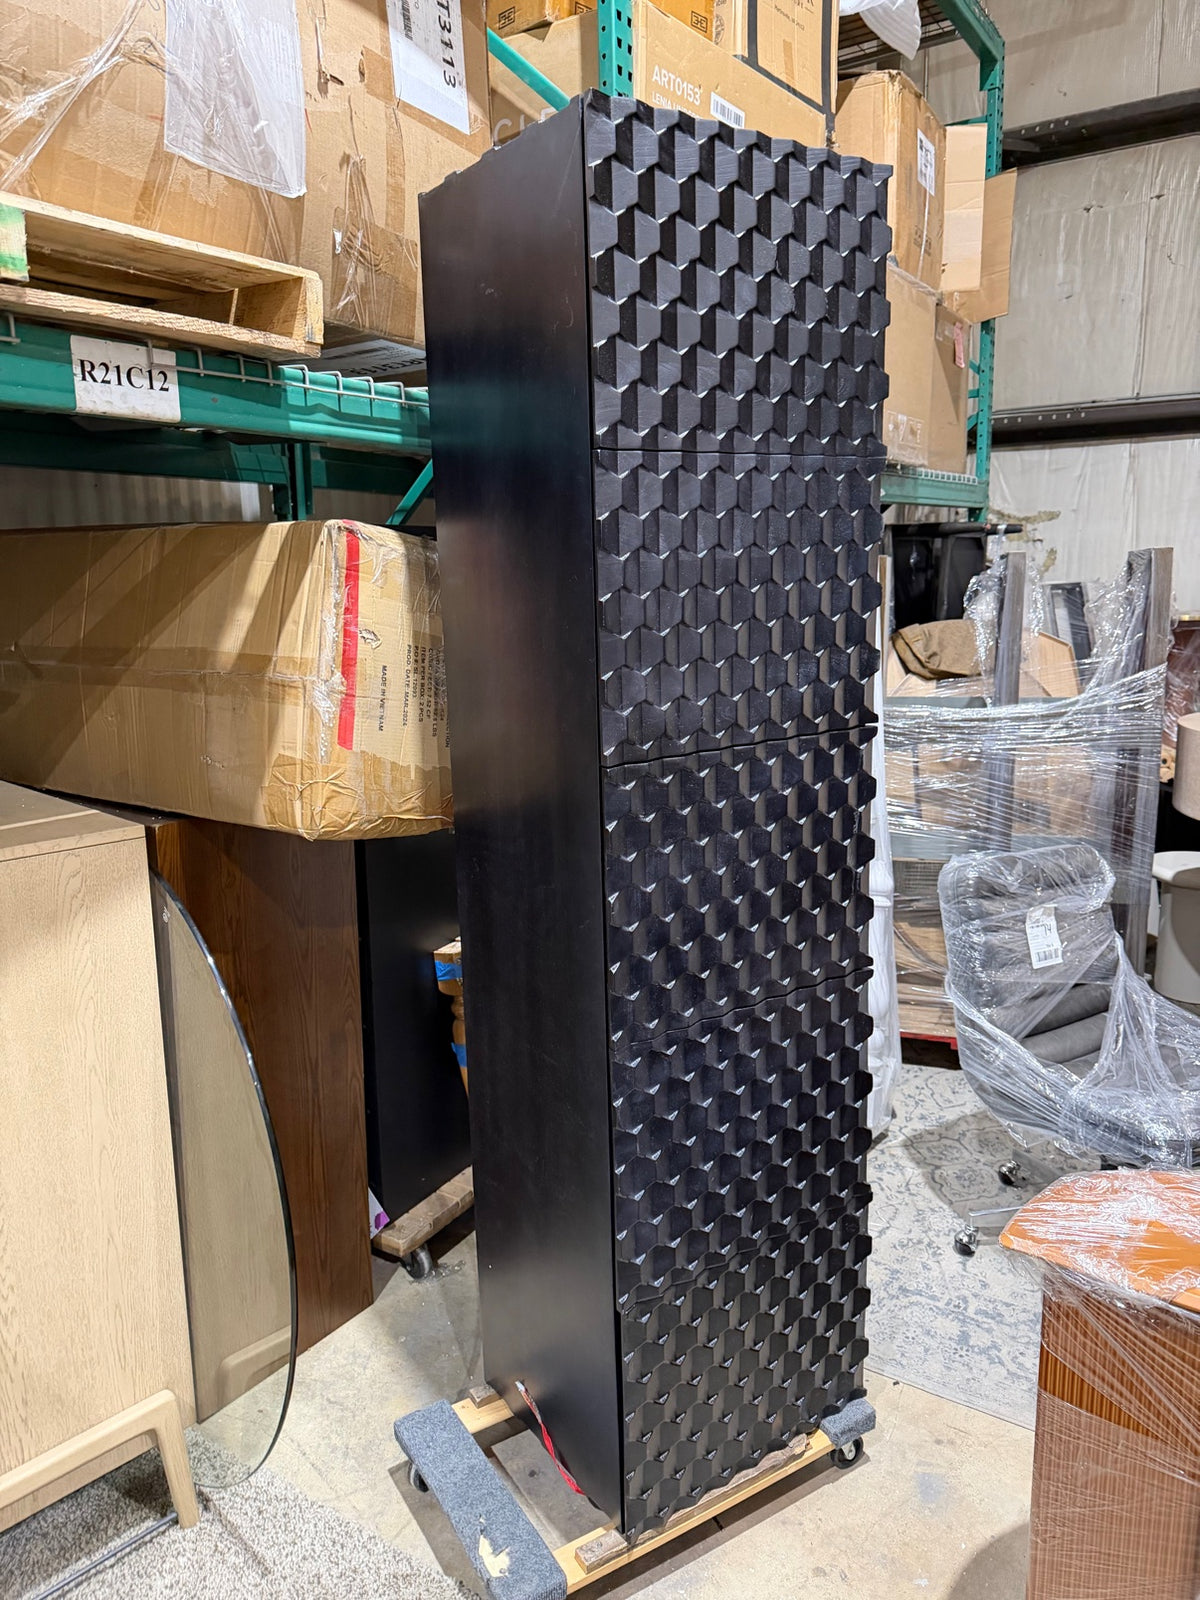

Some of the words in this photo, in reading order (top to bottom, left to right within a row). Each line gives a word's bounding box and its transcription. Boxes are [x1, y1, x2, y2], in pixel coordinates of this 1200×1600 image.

[652, 64, 701, 106] ART0153
[77, 358, 170, 392] R21C12
[381, 689, 386, 697] IN
